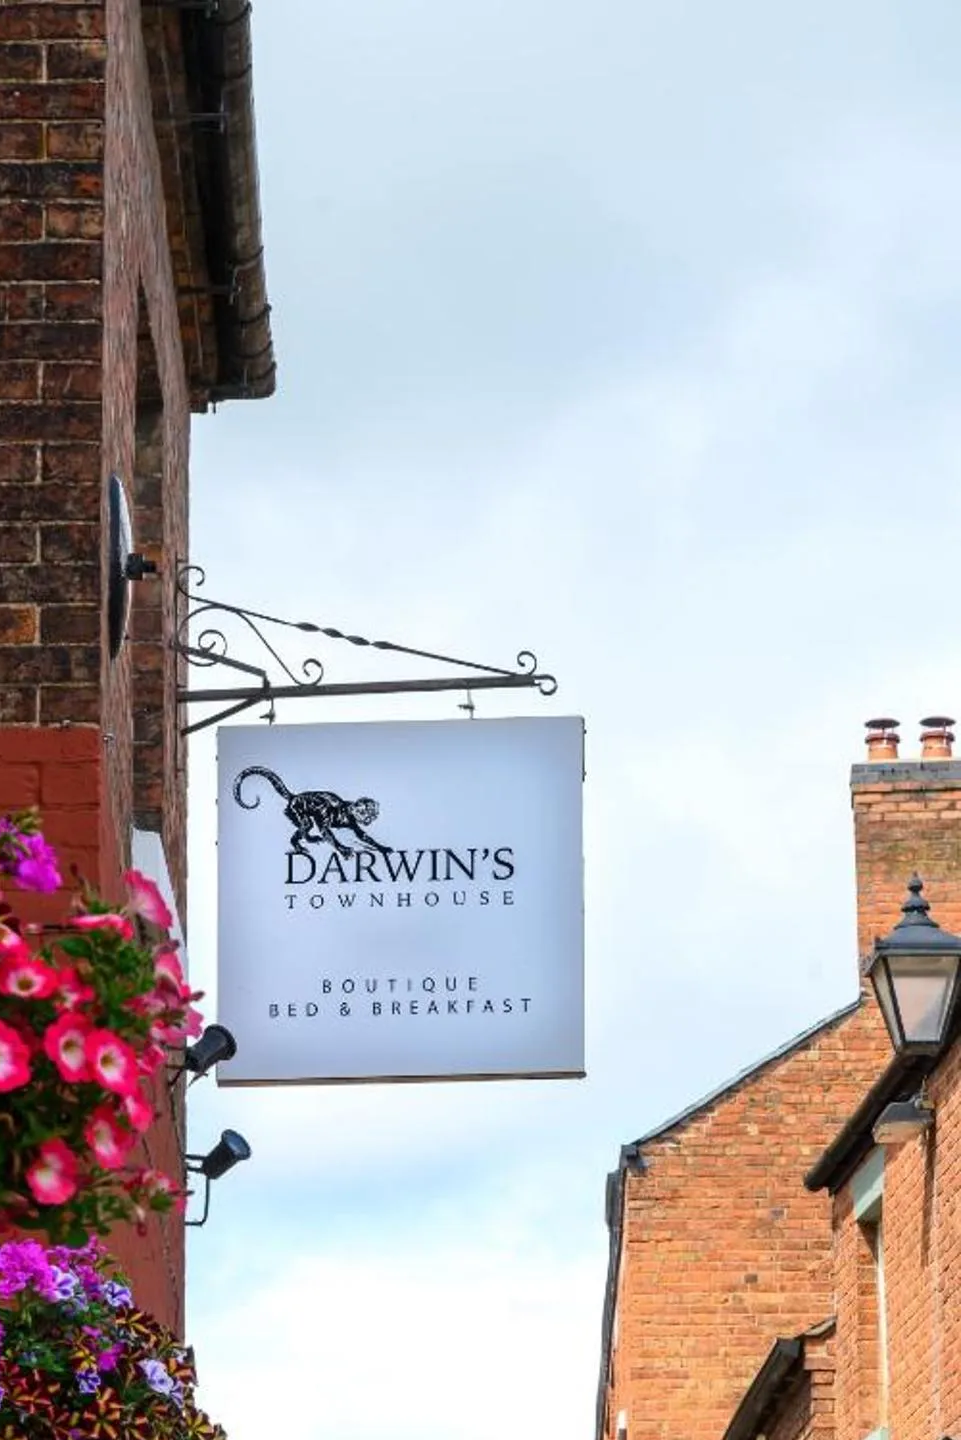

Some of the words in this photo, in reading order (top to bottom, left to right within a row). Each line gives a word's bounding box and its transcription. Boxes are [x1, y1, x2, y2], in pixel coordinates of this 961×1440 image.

[284, 847, 515, 884] DARWIN'S
[284, 891, 515, 909] TOWNHOUSE
[321, 977, 479, 994] BOUTIQUE
[269, 1003, 318, 1018] BED
[339, 1003, 351, 1017] &
[372, 999, 531, 1016] BREAKFAST
